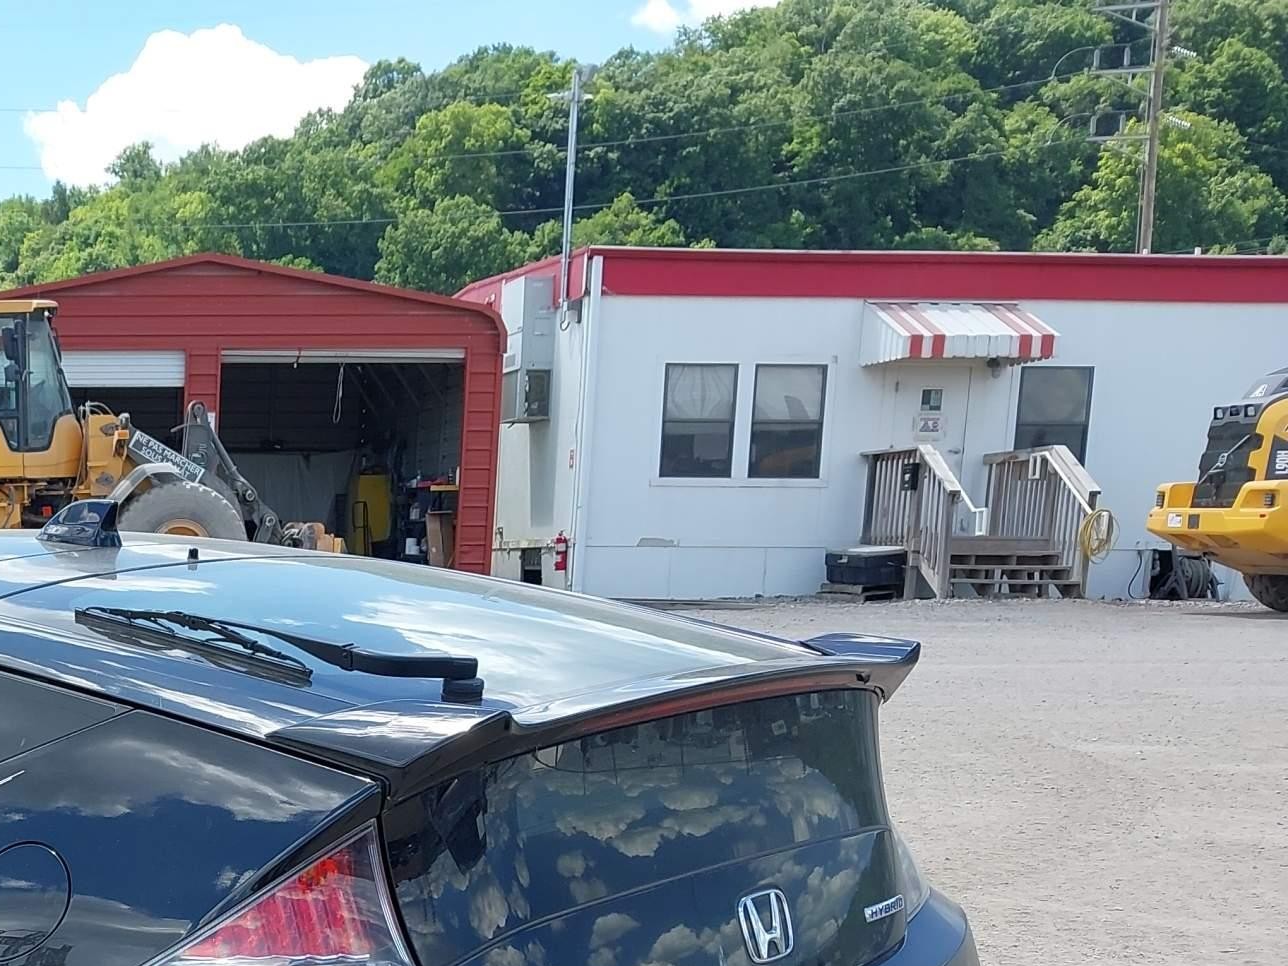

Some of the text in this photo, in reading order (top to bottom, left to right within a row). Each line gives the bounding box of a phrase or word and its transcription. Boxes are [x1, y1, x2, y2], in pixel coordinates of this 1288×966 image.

[136, 433, 200, 476] NE PAS MARCHER
[141, 446, 163, 462] SOUS
[871, 897, 903, 918] HYBRID
